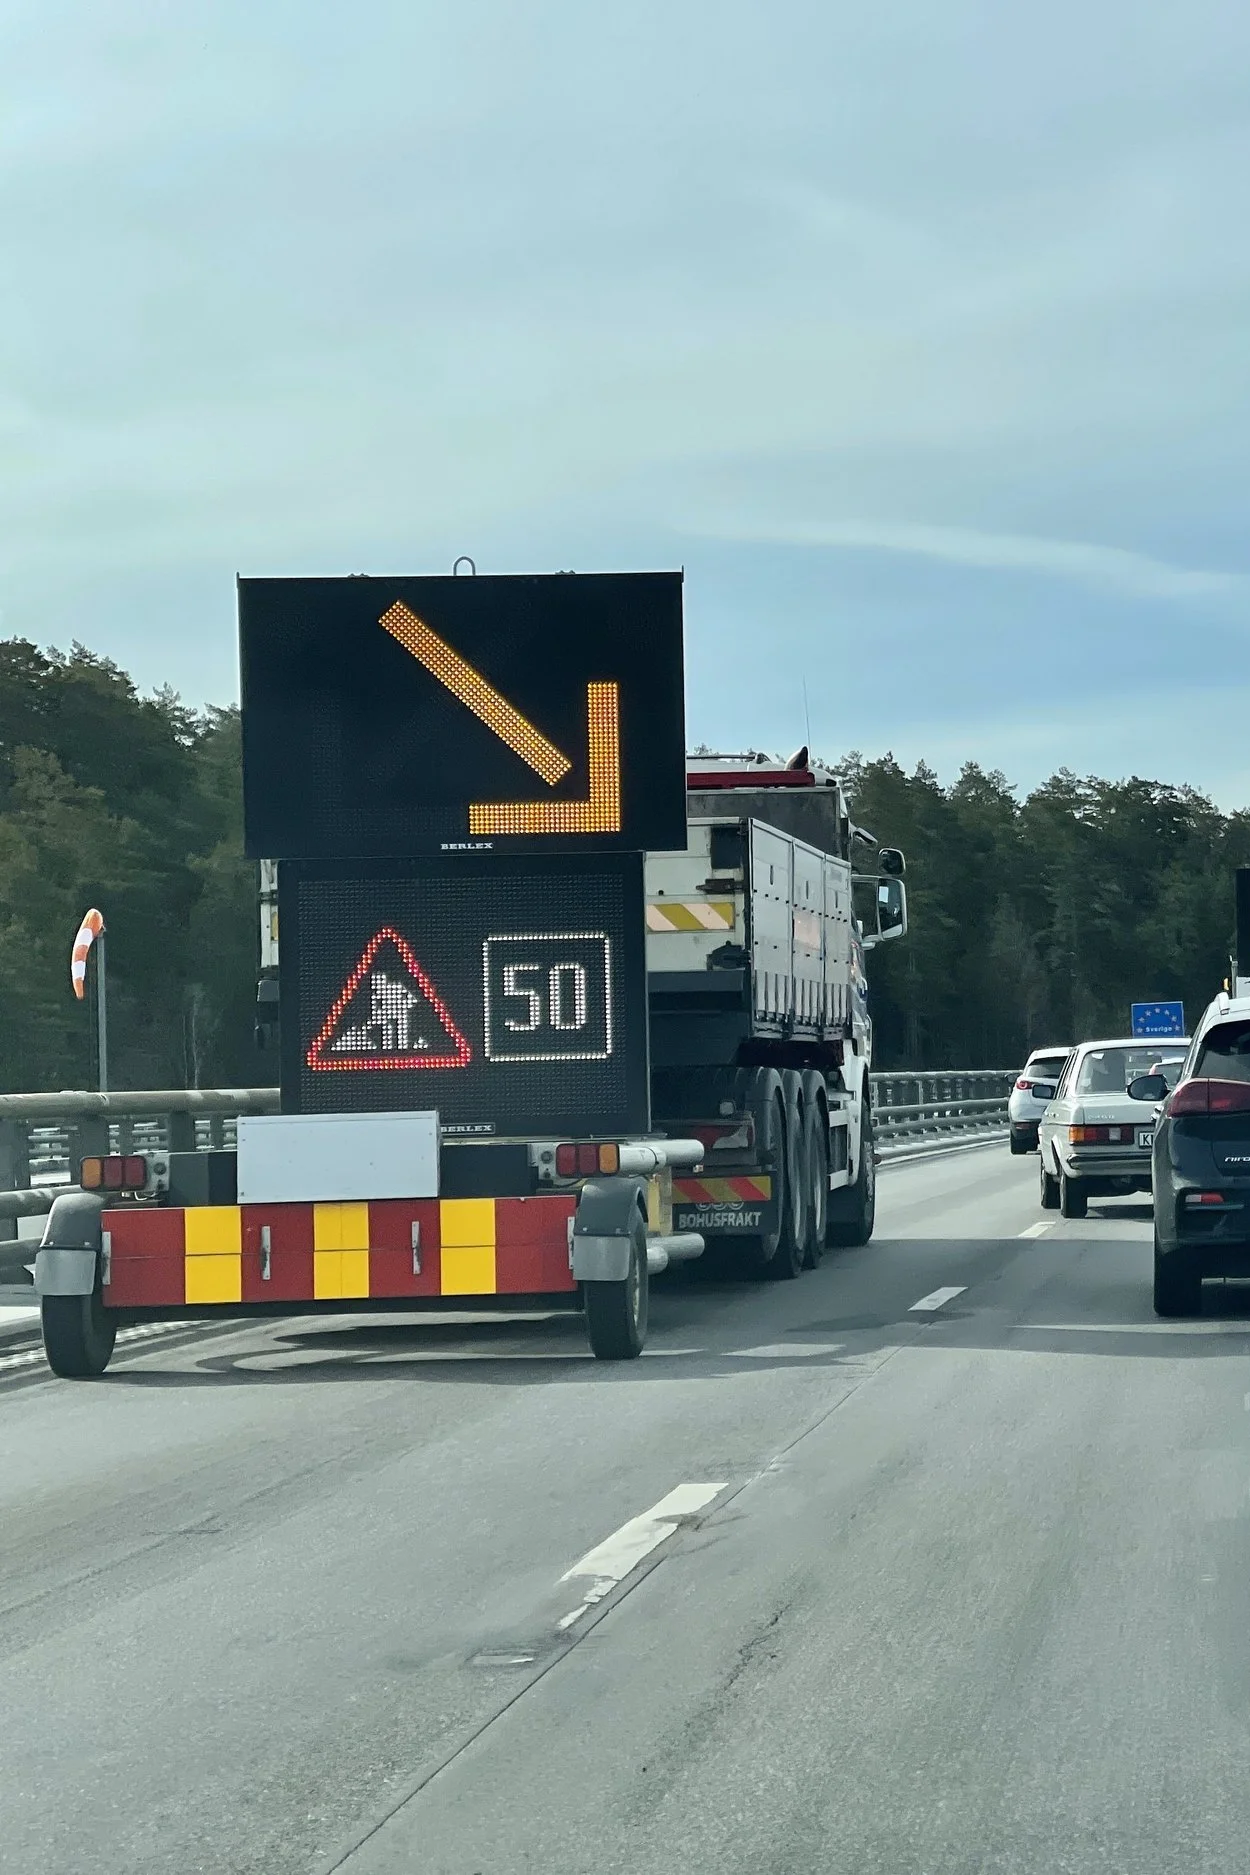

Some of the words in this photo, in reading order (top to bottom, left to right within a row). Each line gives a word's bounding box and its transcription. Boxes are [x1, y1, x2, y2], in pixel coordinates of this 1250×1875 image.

[440, 842, 493, 850] BERLEX
[503, 963, 586, 1031] 50
[440, 1124, 492, 1132] BERLEX
[679, 1211, 761, 1228] BOHUSFRAKT
